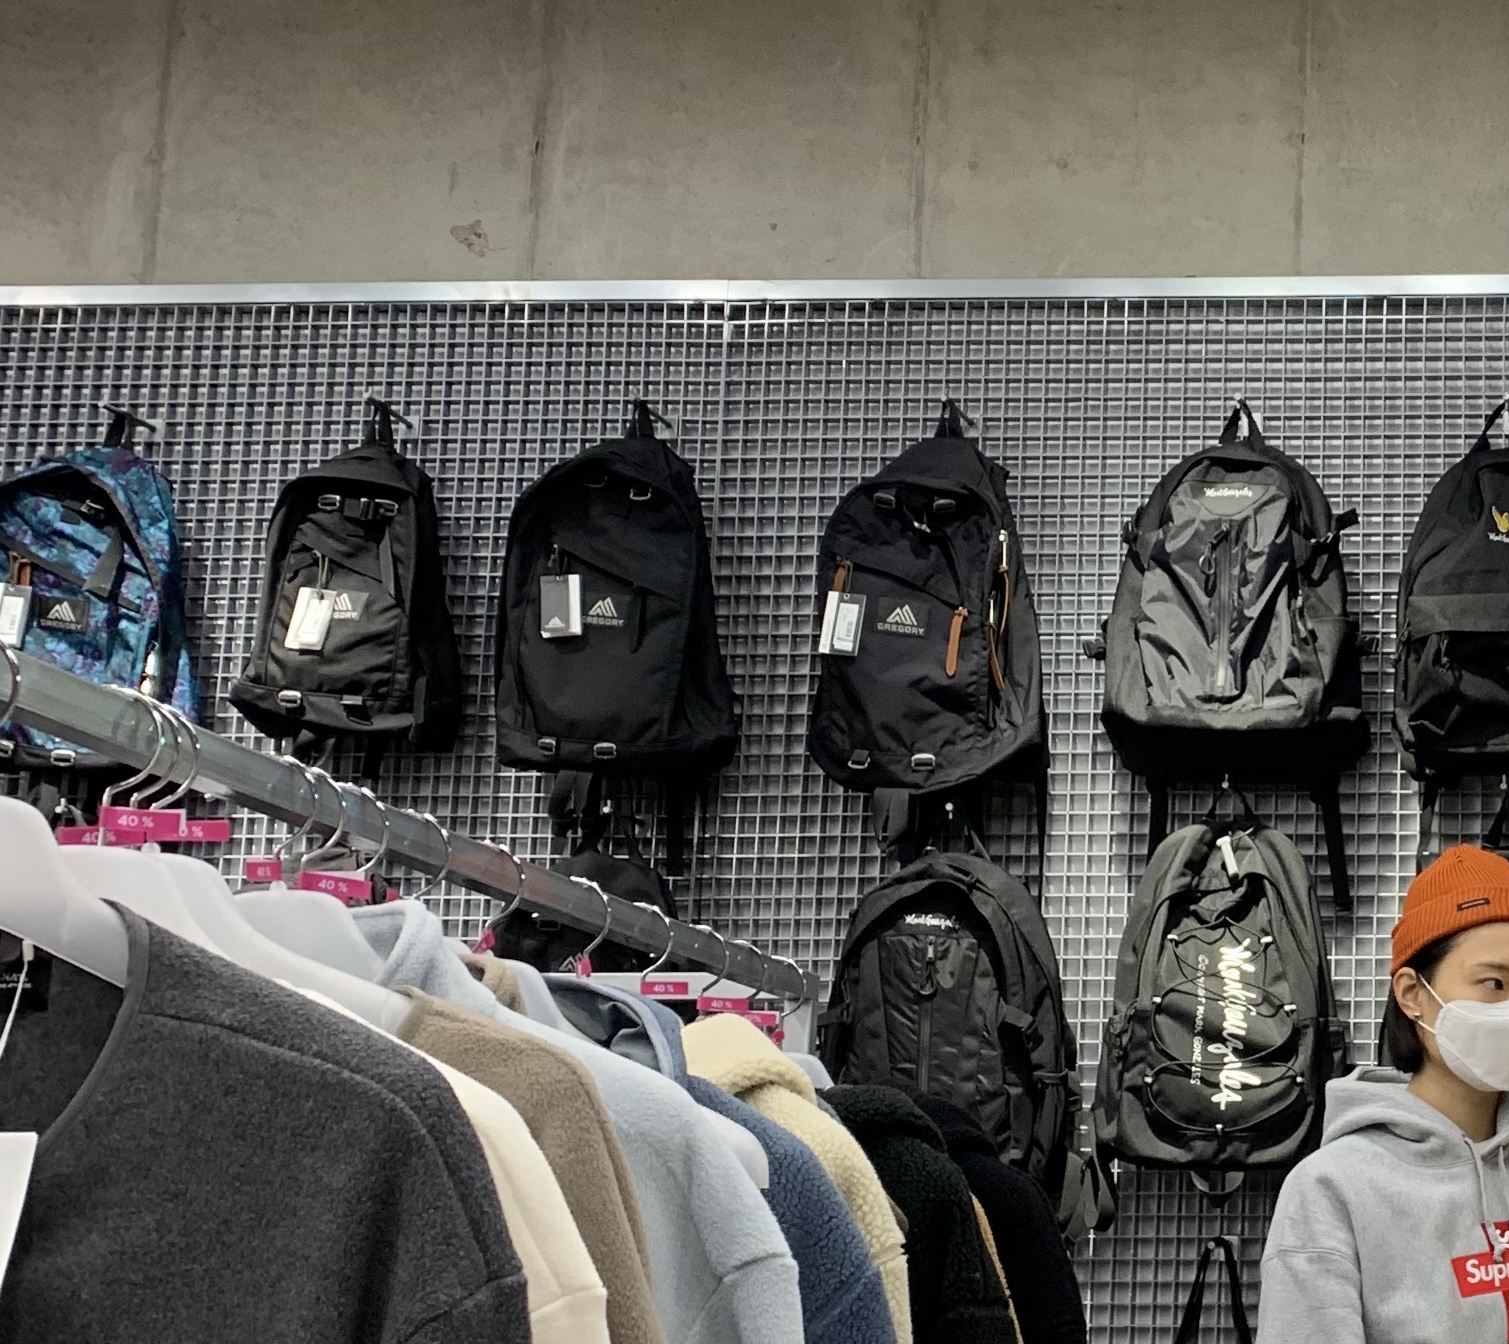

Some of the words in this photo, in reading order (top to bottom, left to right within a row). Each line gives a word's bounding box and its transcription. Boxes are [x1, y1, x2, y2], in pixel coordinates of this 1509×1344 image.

[876, 621, 926, 636] GREGORY
[116, 814, 140, 828] 40
[141, 814, 155, 829] %
[318, 879, 335, 890] 40
[337, 880, 349, 893] %
[652, 984, 666, 993] 40
